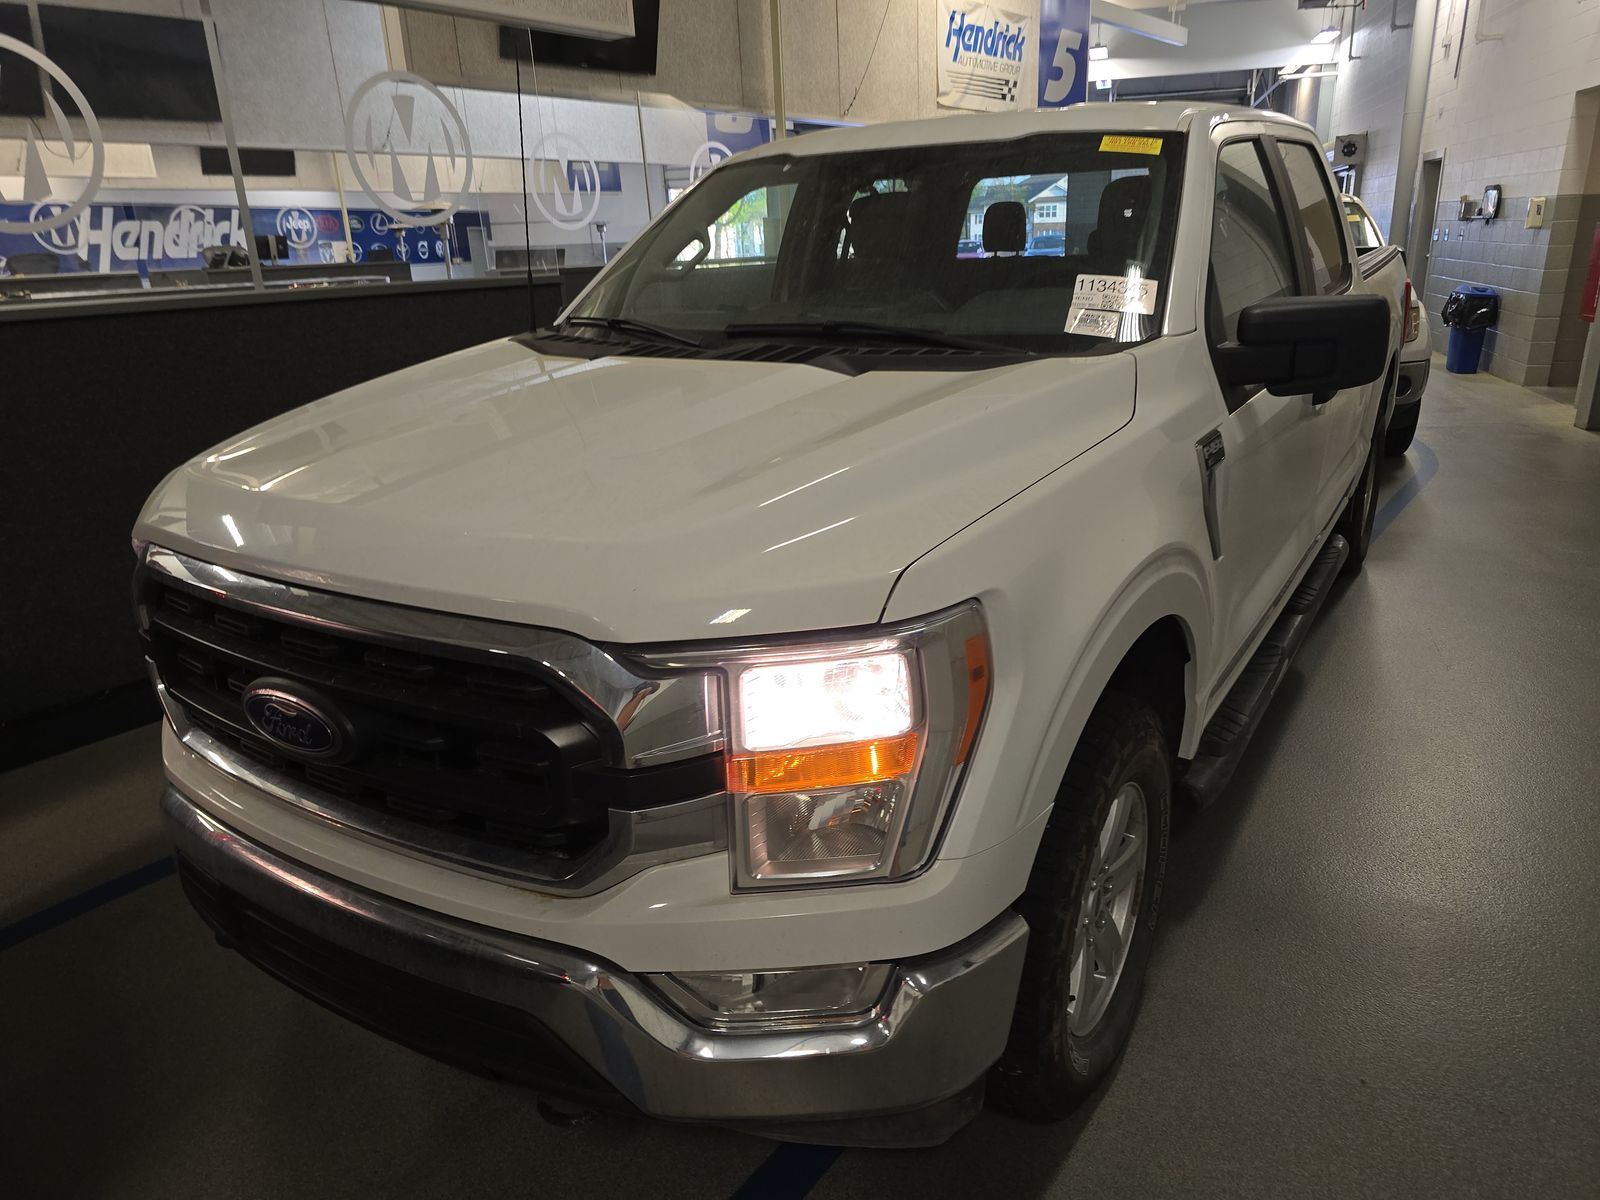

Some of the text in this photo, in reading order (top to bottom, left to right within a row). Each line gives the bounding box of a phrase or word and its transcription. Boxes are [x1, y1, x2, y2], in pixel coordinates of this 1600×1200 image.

[945, 9, 1026, 63] Hendrick
[957, 55, 1021, 75] AUTOMOTIVE GROUP
[1044, 27, 1083, 103] 5
[78, 206, 247, 273] Hendrick
[286, 214, 312, 233] Jeep
[1077, 278, 1149, 297] 113435
[261, 702, 314, 745] Ford
